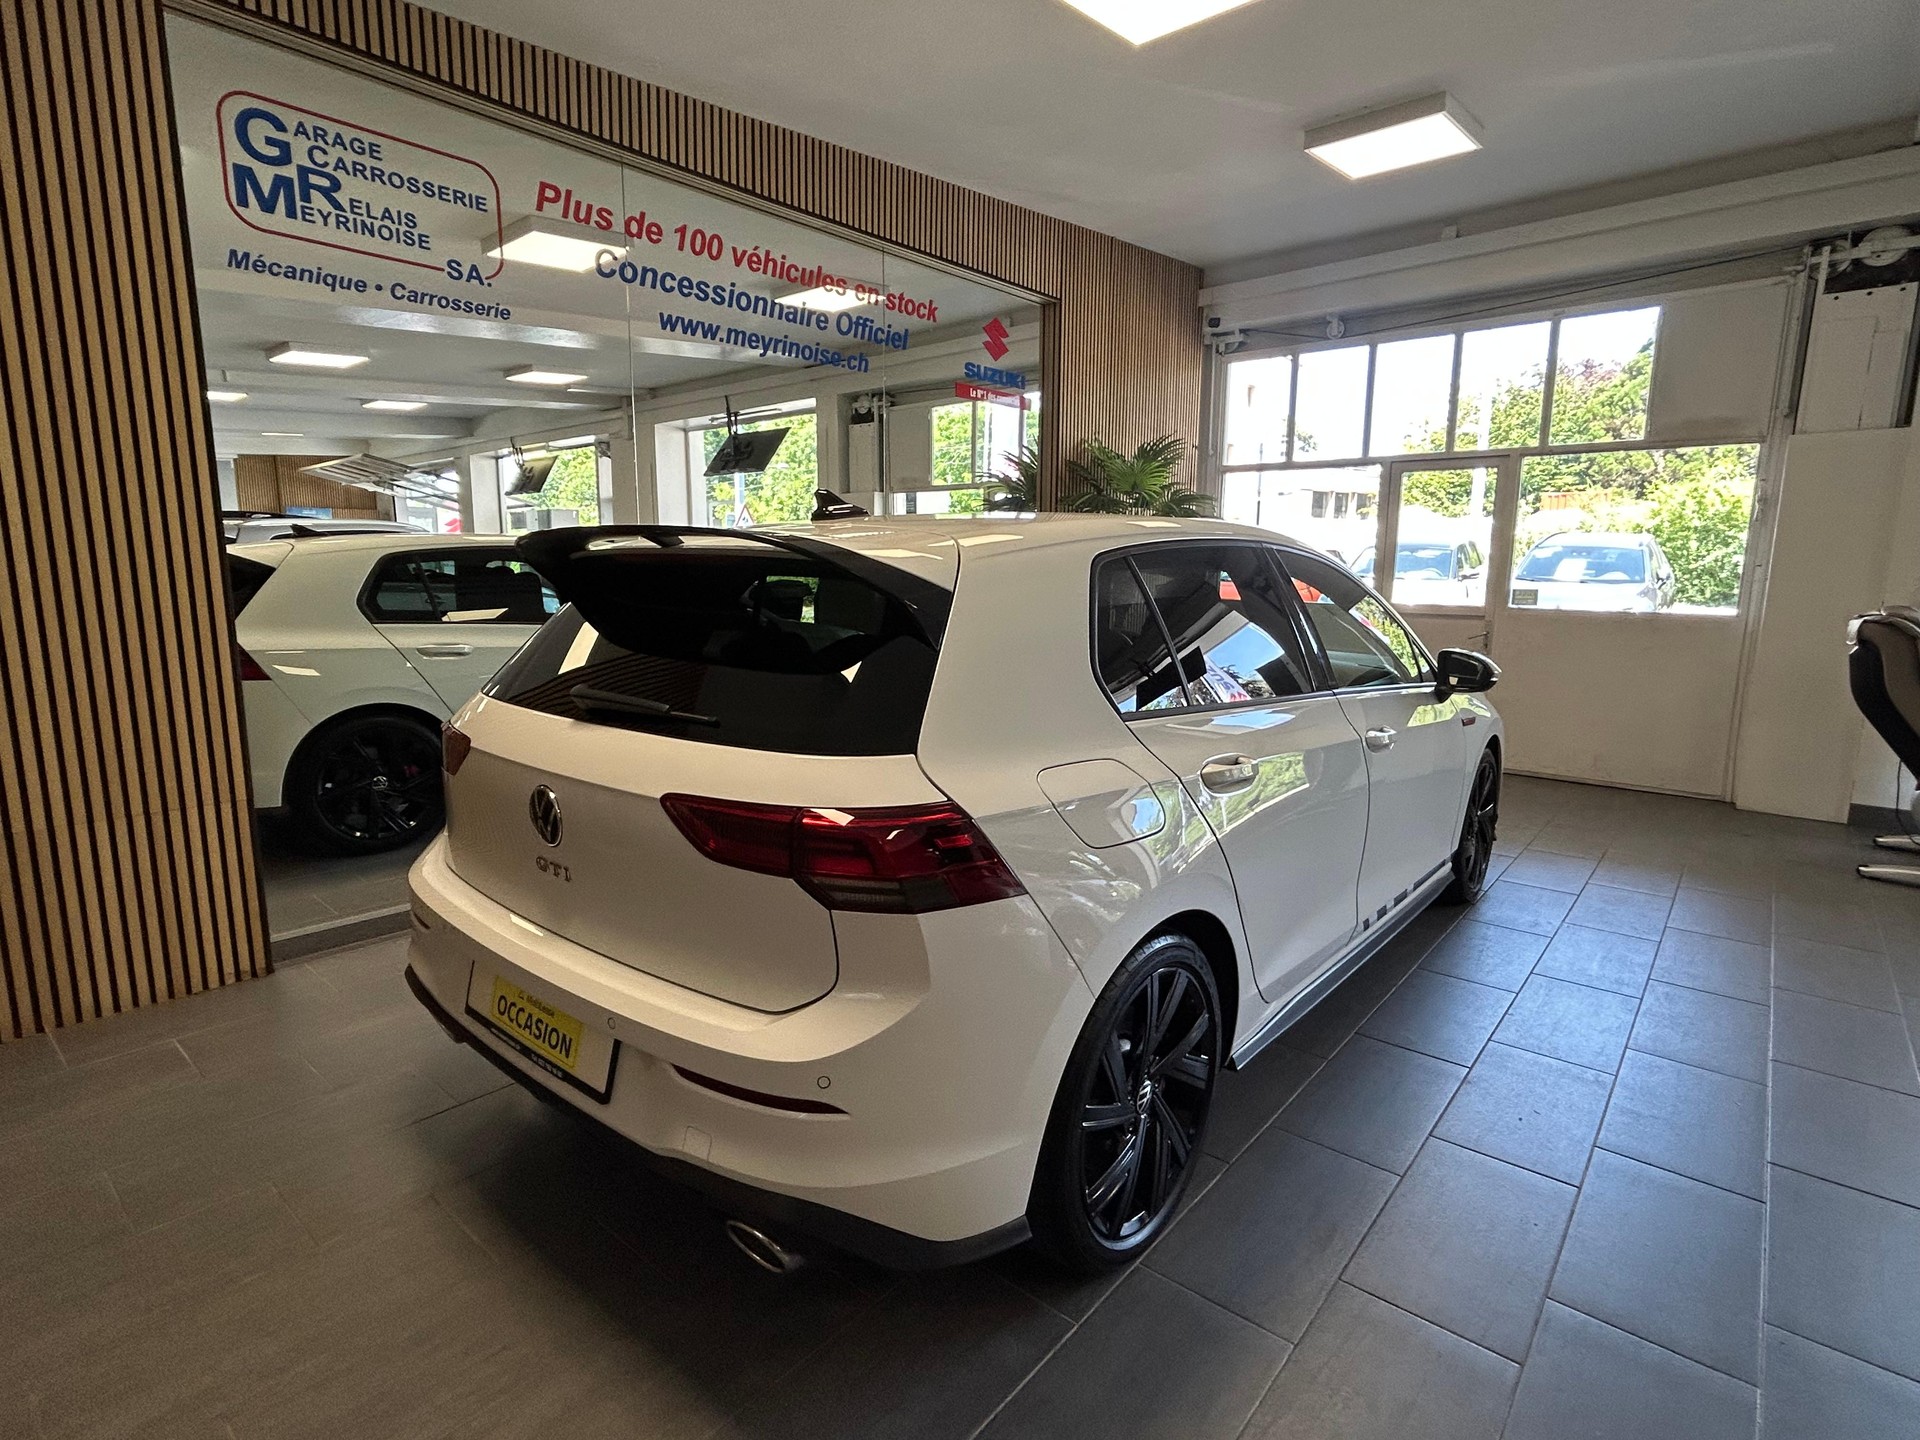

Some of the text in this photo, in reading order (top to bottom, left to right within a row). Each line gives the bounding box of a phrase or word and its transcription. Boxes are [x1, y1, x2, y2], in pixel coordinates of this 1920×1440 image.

[234, 107, 383, 167] GARAGE
[232, 162, 431, 250] MEYRINOISE
[296, 163, 418, 229] RELAIS
[307, 144, 489, 213] CARROSSERIE
[227, 248, 512, 321] Mécanique Carrosserie
[535, 180, 939, 323] Plus de 100 véhicules en stock
[594, 248, 909, 351] Concessionnaire Officiel
[658, 311, 870, 374] www.meyrinoise.ch
[963, 361, 1026, 390] SUZUKI
[535, 856, 572, 883] GTI
[497, 994, 573, 1059] OCCASION
